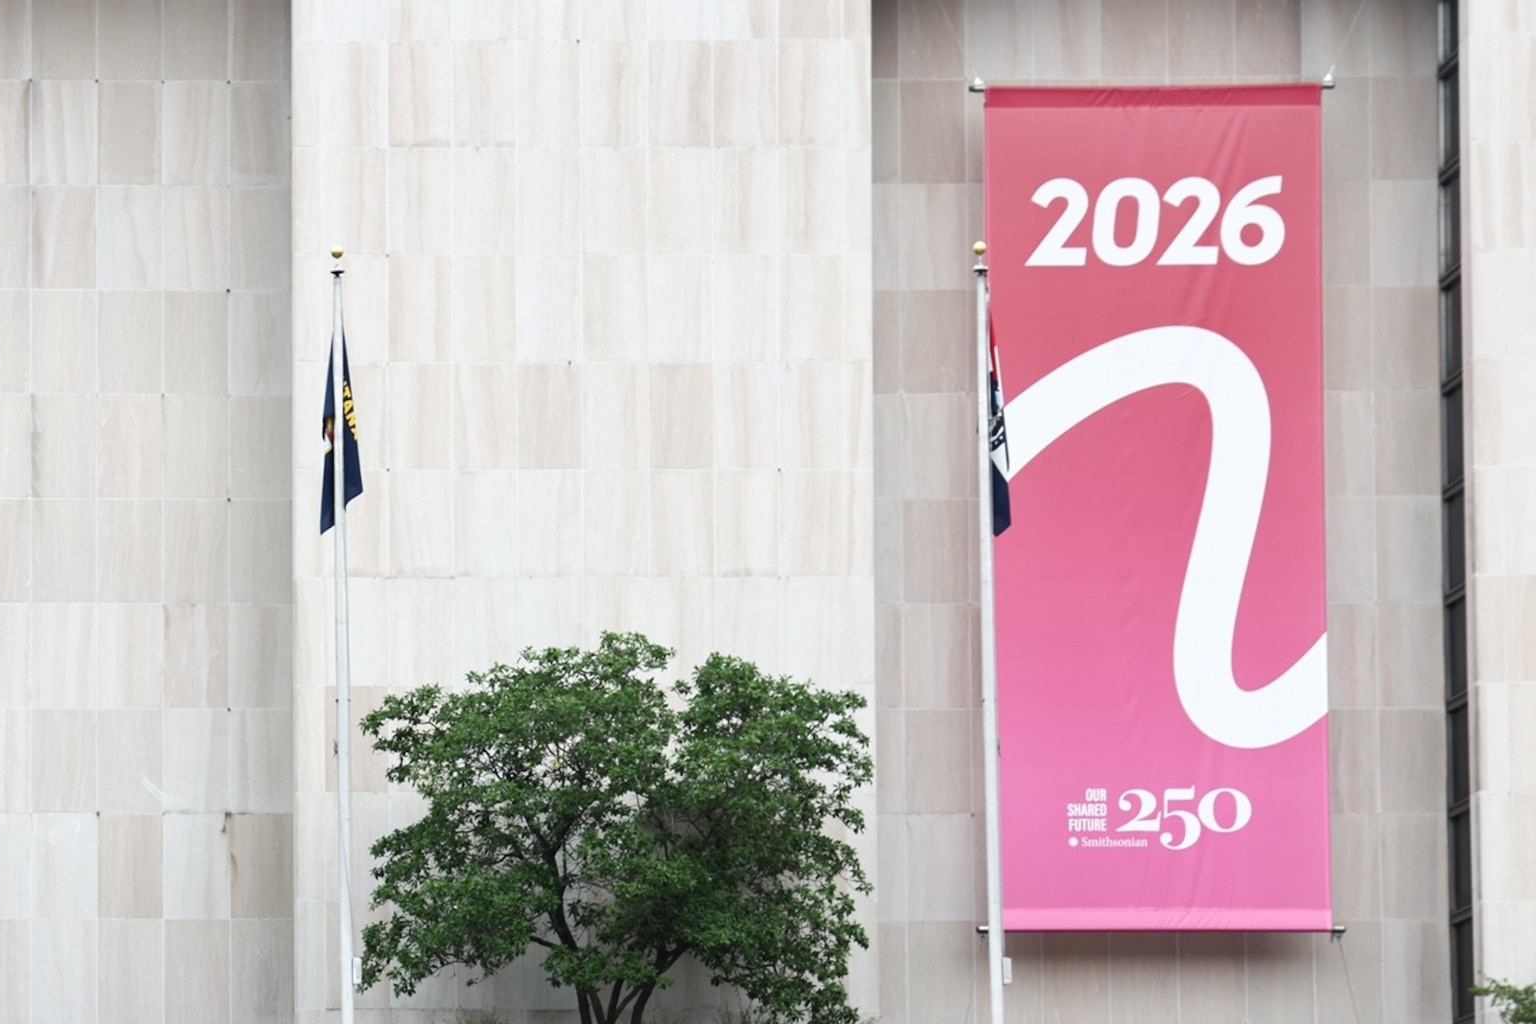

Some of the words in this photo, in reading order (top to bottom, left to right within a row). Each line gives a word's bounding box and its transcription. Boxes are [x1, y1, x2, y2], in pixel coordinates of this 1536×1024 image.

[1023, 175, 1285, 267] 2026
[1085, 788, 1107, 802] OUR
[1067, 803, 1107, 817] SHARED
[1115, 785, 1252, 850] 250
[1068, 818, 1107, 832] FUTURE
[1081, 836, 1148, 847] Smithsonian
